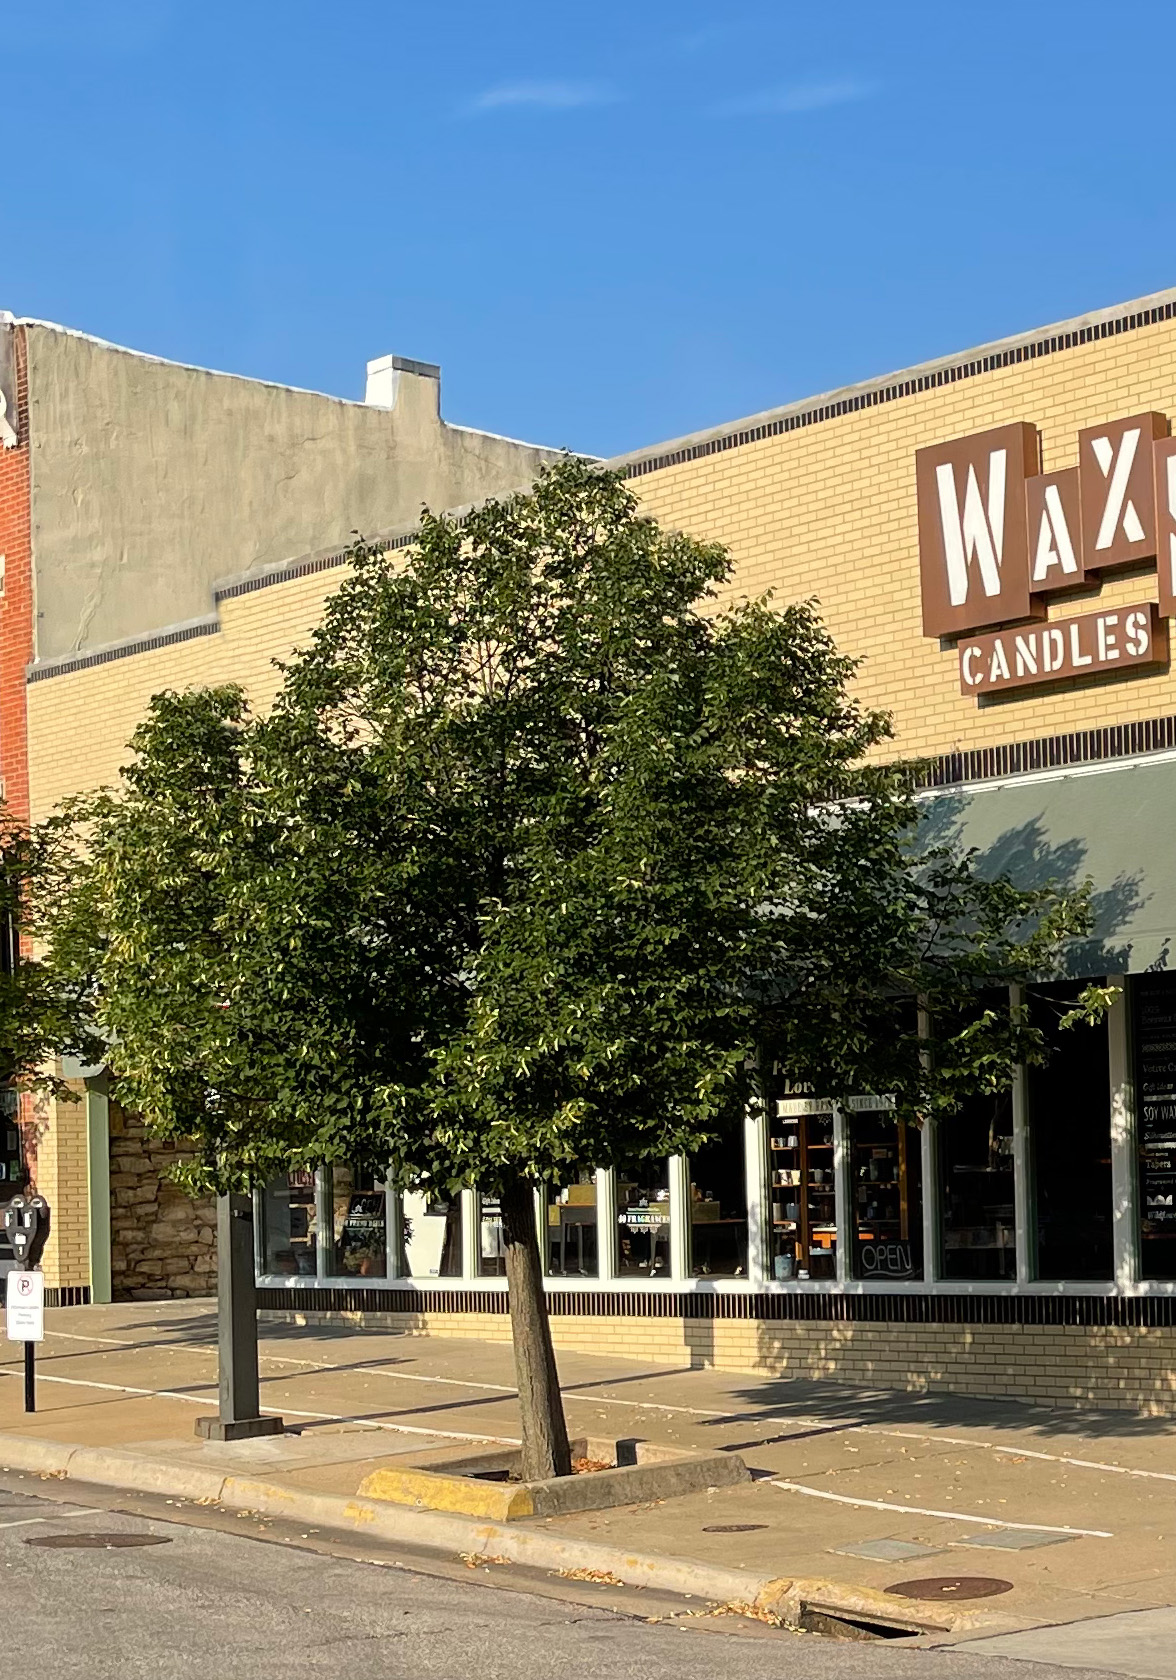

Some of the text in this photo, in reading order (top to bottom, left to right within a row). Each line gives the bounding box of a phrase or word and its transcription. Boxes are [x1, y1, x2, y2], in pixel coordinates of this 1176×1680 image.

[962, 611, 1150, 686] CANDLES
[1143, 1106, 1159, 1121] SOY
[862, 1244, 912, 1271] OPEN
